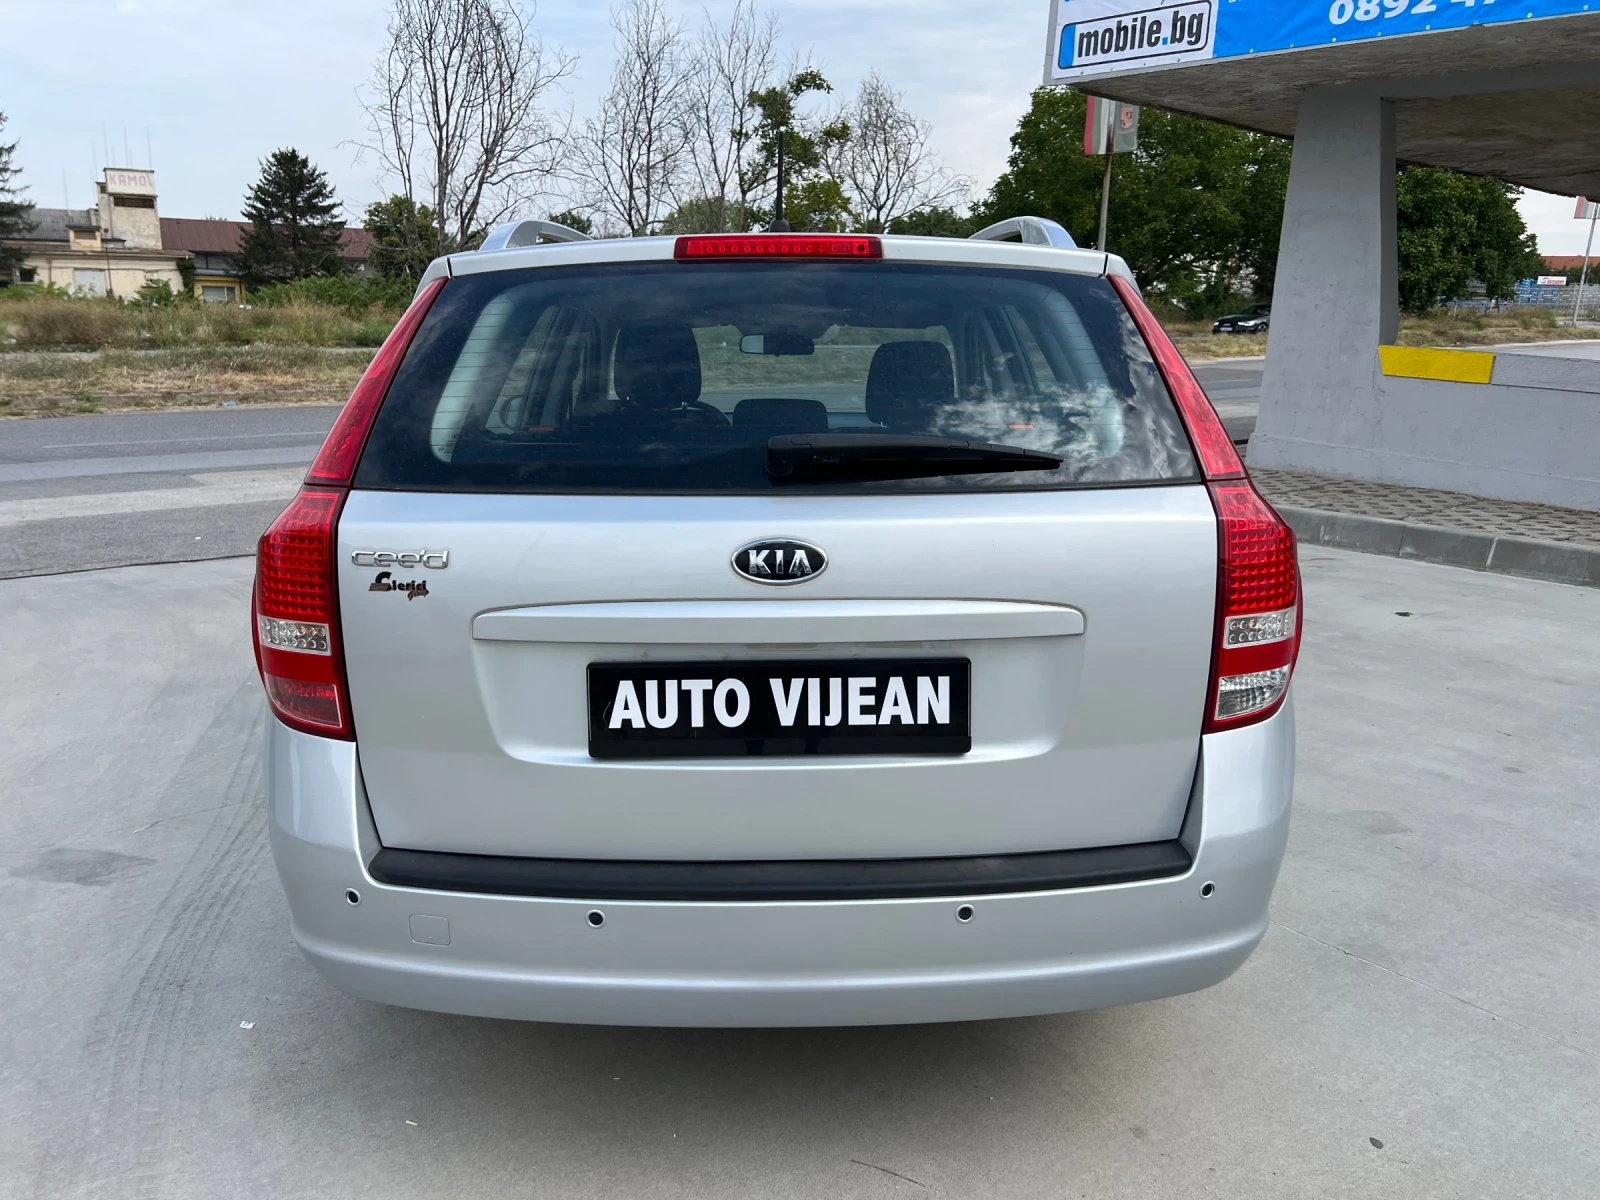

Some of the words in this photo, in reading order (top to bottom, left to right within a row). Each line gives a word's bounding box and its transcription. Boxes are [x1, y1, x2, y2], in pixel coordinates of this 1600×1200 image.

[1077, 10, 1204, 58] mobile.bg
[351, 549, 449, 570] cee'd
[747, 549, 813, 574] KIA
[608, 678, 750, 729] AUTO
[769, 675, 951, 727] VIJEAN
